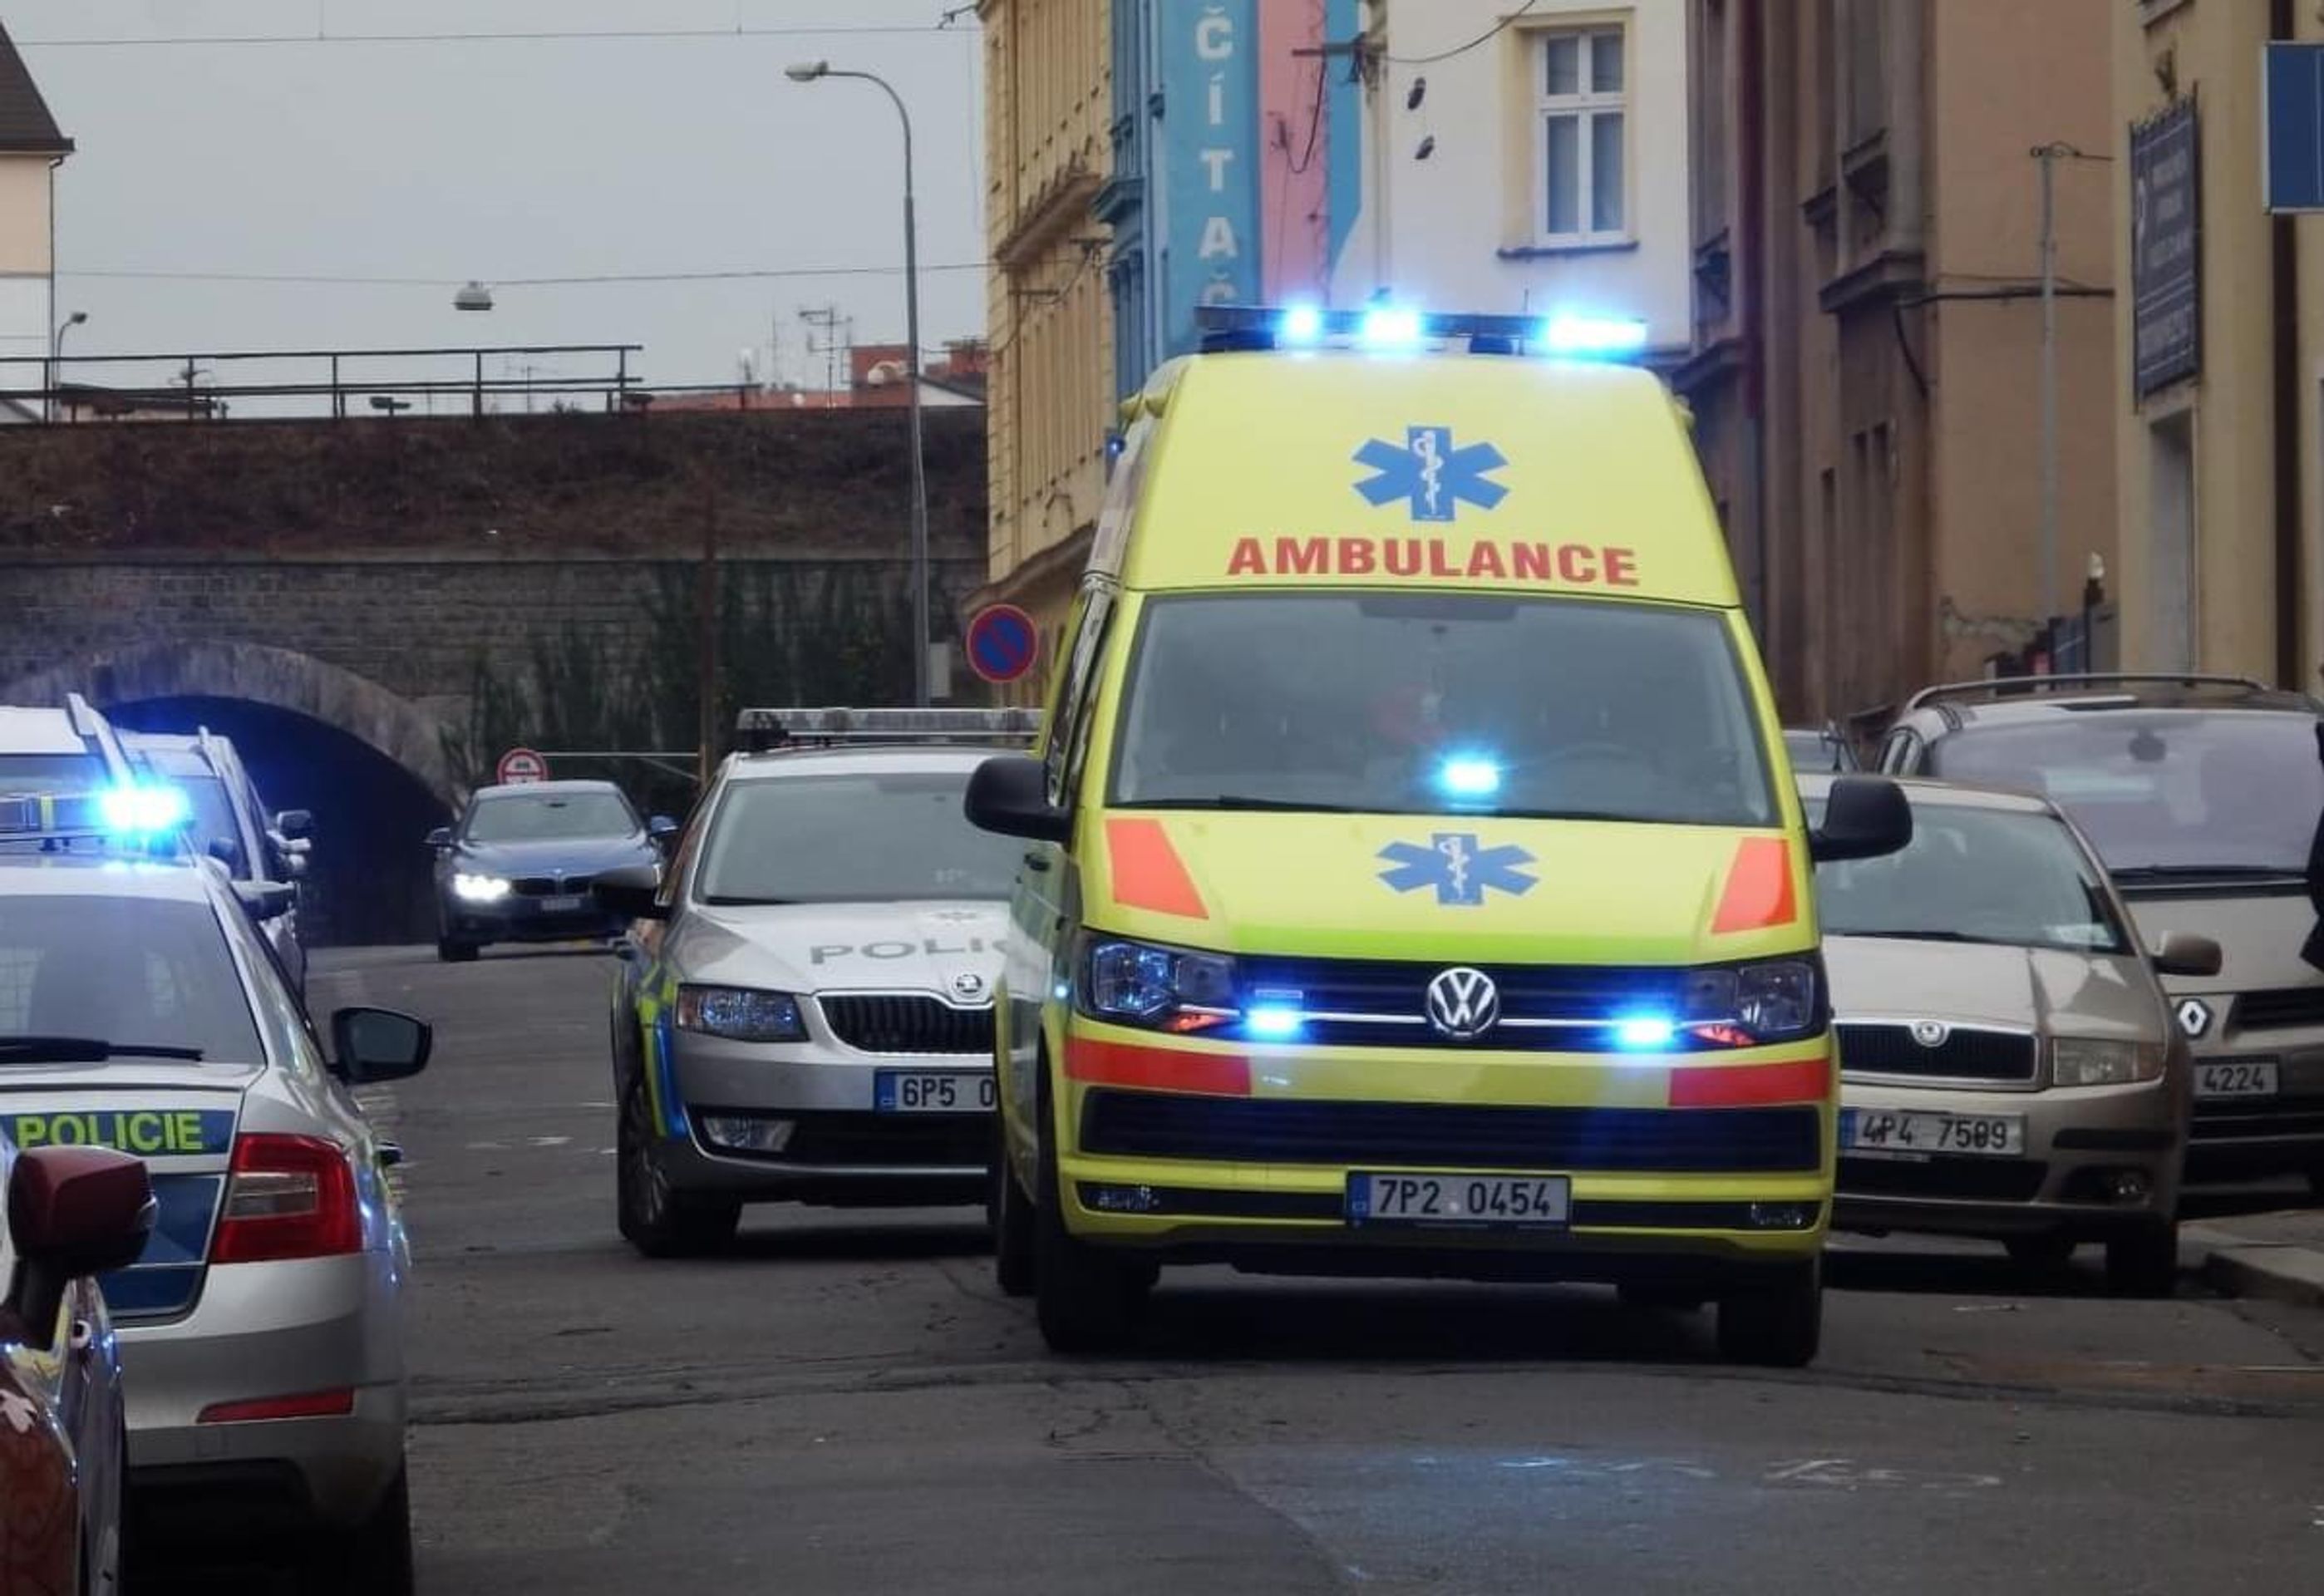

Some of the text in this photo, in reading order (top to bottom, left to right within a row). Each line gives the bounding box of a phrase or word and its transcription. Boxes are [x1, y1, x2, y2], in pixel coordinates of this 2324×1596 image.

[1227, 536, 1641, 586] AMBULANCE
[902, 1079, 956, 1106] 6P5
[2203, 1066, 2263, 1091] 4224
[16, 1111, 203, 1152] POLICIE
[1862, 1116, 1913, 1145] 4P4
[1378, 1179, 1551, 1216] 7P2 0454
